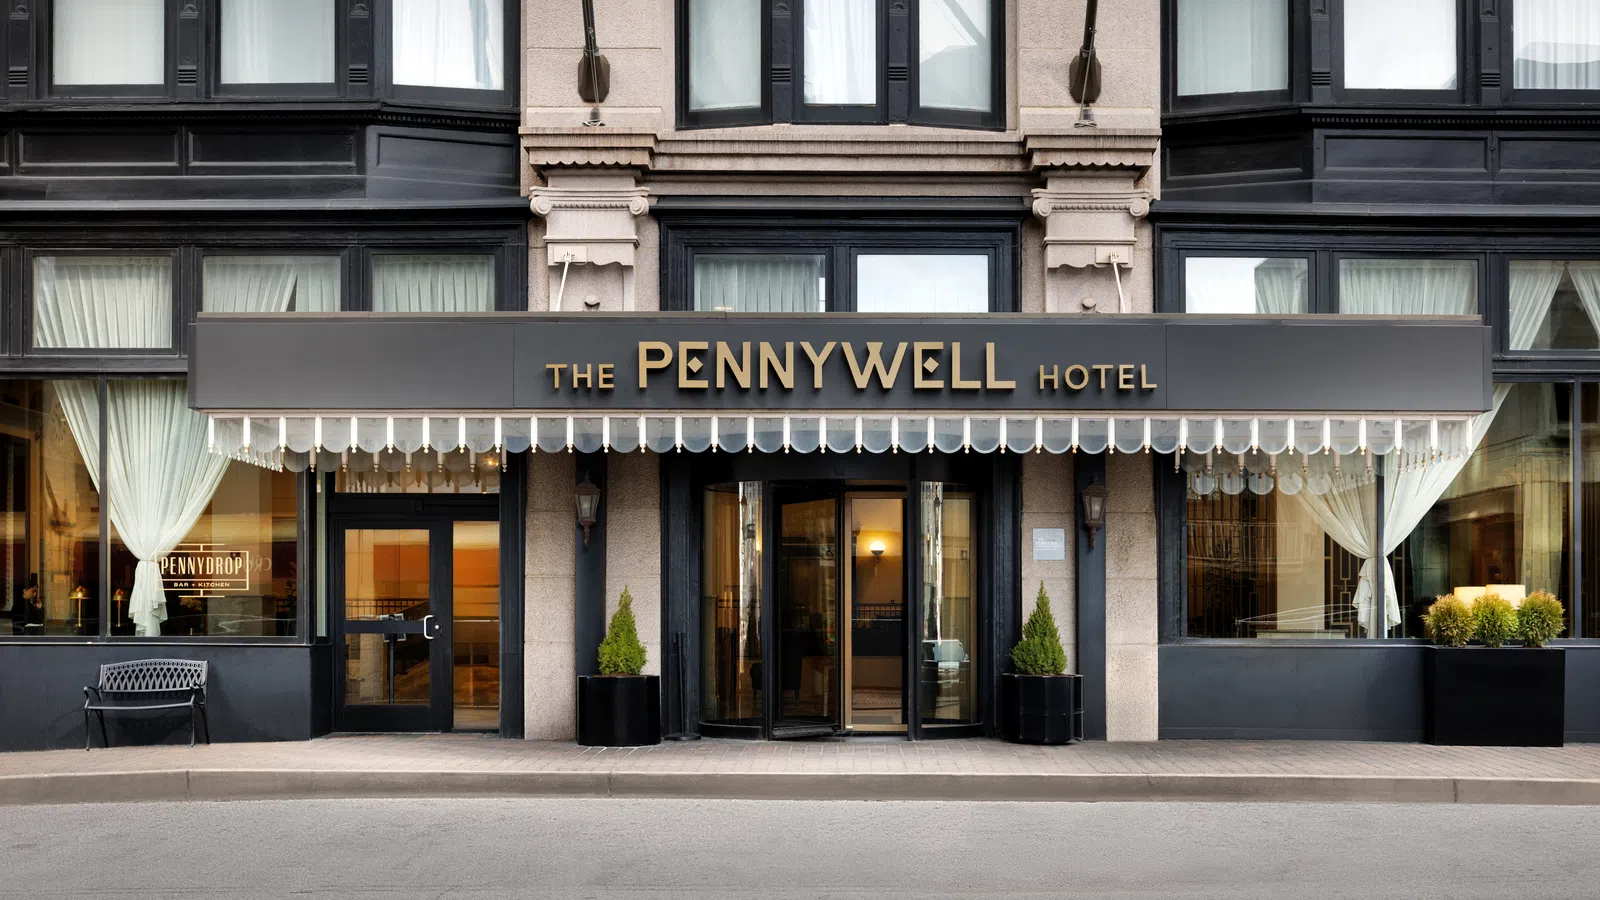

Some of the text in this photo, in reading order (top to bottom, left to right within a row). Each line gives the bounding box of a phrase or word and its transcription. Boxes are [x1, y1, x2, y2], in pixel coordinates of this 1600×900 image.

[546, 341, 1157, 390] THE PENNYWELL HOTEL
[161, 556, 243, 575] PENNYDROP
